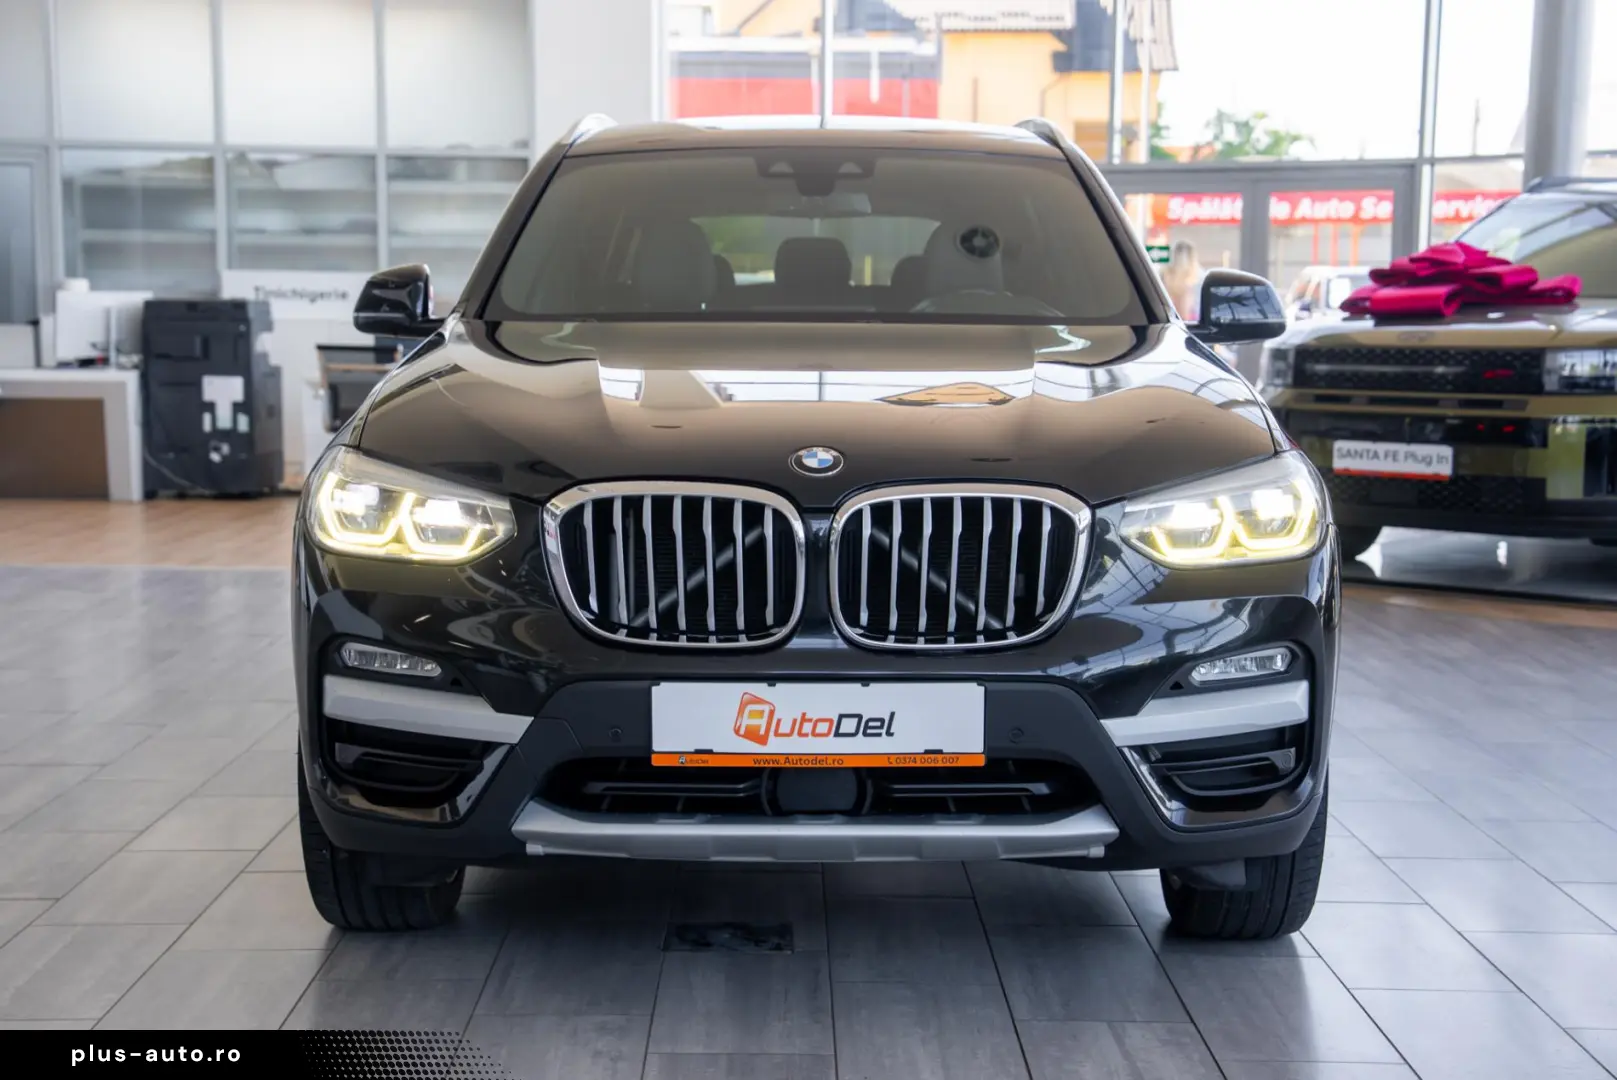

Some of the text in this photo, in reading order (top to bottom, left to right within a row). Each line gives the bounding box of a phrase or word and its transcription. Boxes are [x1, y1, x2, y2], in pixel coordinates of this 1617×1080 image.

[1294, 197, 1356, 219] Auto
[1360, 195, 1393, 219] Se
[1336, 447, 1449, 467] SANTA FE Plug In
[734, 692, 896, 746] AutoDel
[752, 756, 844, 766] www.Autodel.ro
[895, 756, 917, 765] 0374
[941, 756, 960, 765] 007
